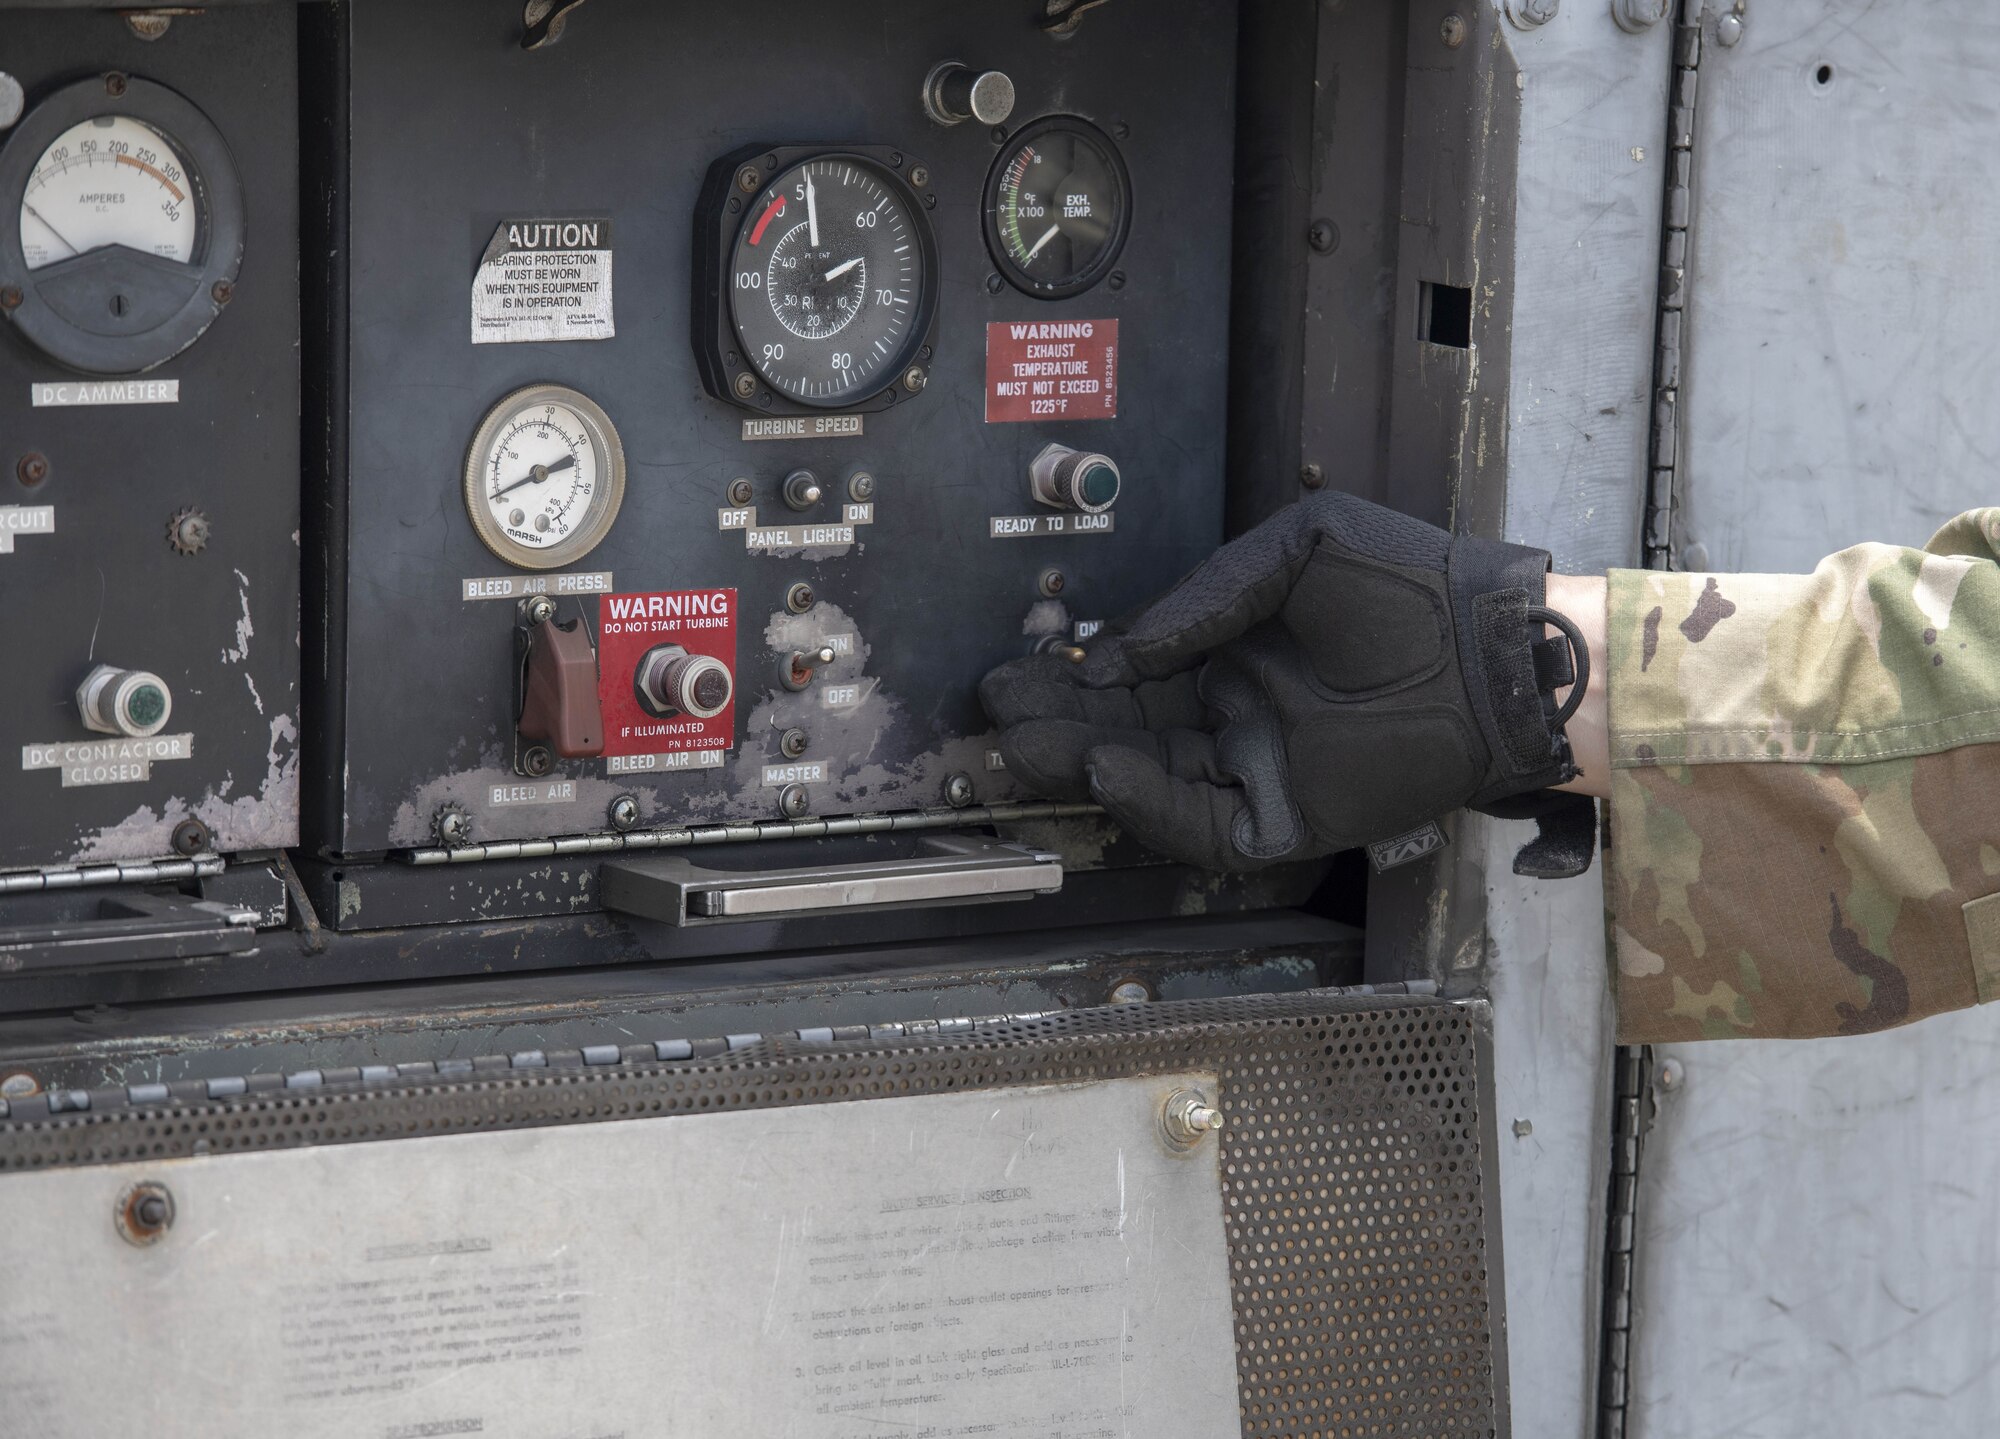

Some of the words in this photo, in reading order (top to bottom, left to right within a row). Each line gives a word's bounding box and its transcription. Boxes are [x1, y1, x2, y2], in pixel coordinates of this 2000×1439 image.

[80, 140, 97, 152] 150
[109, 140, 128, 154] 200
[51, 146, 69, 162] 100
[136, 148, 156, 165] 250
[160, 163, 180, 182] 300
[79, 193, 126, 204] AMPERES
[1066, 195, 1090, 205] EXH.
[162, 201, 180, 222] 350
[1063, 207, 1092, 217] TEMP.
[856, 212, 876, 228] 60
[489, 256, 532, 266] HEARING
[535, 254, 597, 265] PROTECTION
[782, 257, 796, 268] 40
[504, 270, 533, 280] MUST
[535, 269, 548, 279] BE
[550, 268, 581, 279] WORN
[736, 272, 760, 289] 100
[486, 284, 515, 294] WHEN
[518, 283, 540, 294] THIS
[542, 282, 599, 293] EQUIPMENT
[502, 298, 511, 308] IS
[514, 298, 524, 308] IN
[526, 296, 582, 308] OPERATION
[784, 295, 798, 306] 30
[837, 296, 847, 308] 10
[876, 290, 892, 305] 70
[807, 315, 820, 326] 20
[1010, 323, 1093, 340] WARNING
[763, 344, 784, 360] 90
[1027, 344, 1075, 358] EXHAUST
[832, 353, 851, 370] 80
[1013, 361, 1088, 377] TEMPERATURE
[43, 387, 68, 403] DC
[77, 382, 168, 401] AMMETER
[997, 382, 1027, 396] MUST
[1033, 381, 1054, 394] NOT
[1060, 380, 1099, 394] EXCEED
[1031, 399, 1068, 414] 1225°F
[1105, 395, 1112, 408] PN
[545, 406, 555, 414] 30
[745, 419, 805, 436] TURBINE
[816, 417, 858, 433] SPEED
[537, 430, 549, 440] 200
[578, 433, 587, 445] 40
[507, 451, 519, 460] 100
[584, 483, 591, 494] 50
[722, 511, 748, 526] OFF
[849, 505, 868, 520] ON
[559, 524, 569, 535] 60
[995, 518, 1037, 534] READY
[1046, 516, 1064, 531] TO
[1075, 515, 1109, 530] LOAD
[749, 531, 792, 546] PANEL
[803, 528, 852, 544] LIGHTS
[468, 580, 512, 597] BLEED
[523, 578, 547, 593] AIR
[558, 574, 608, 591] PRESS.
[609, 593, 728, 620] WARNING
[605, 623, 622, 634] DO
[625, 621, 648, 632] NOT
[651, 620, 681, 631] START
[686, 617, 729, 630] TURBINE
[1079, 622, 1098, 637] ON
[828, 637, 848, 651] ON
[828, 689, 854, 704] OFF
[621, 727, 630, 737] IF
[634, 723, 704, 737] ILLUMINATED
[668, 740, 680, 749] PN
[686, 737, 725, 747] 8123508
[31, 749, 55, 766] DC
[65, 740, 181, 762] CONTACTOR
[612, 755, 655, 770] BLEED
[665, 752, 688, 767] AIR
[700, 750, 720, 764] ON
[71, 764, 142, 783] CLOSED
[766, 765, 821, 782] MASTER
[493, 787, 537, 802] BLEED
[547, 783, 572, 797] AIR
[811, 1308, 846, 1321] Inspect
[851, 1306, 867, 1316] the
[870, 1304, 884, 1315] air
[889, 1301, 910, 1313] inlet
[1010, 1288, 1052, 1303] openings
[1057, 1285, 1070, 1296] for
[812, 1326, 871, 1340] obstructions
[889, 1320, 924, 1332] foreign
[795, 1367, 805, 1379] 3.
[814, 1362, 845, 1376] Check
[849, 1361, 861, 1372] oil
[866, 1357, 890, 1370] level
[895, 1357, 904, 1367] in
[909, 1354, 921, 1366] oil
[981, 1346, 1006, 1360] glass
[1011, 1342, 1029, 1355] and
[897, 1374, 925, 1386] mark.
[917, 1426, 936, 1439] add
